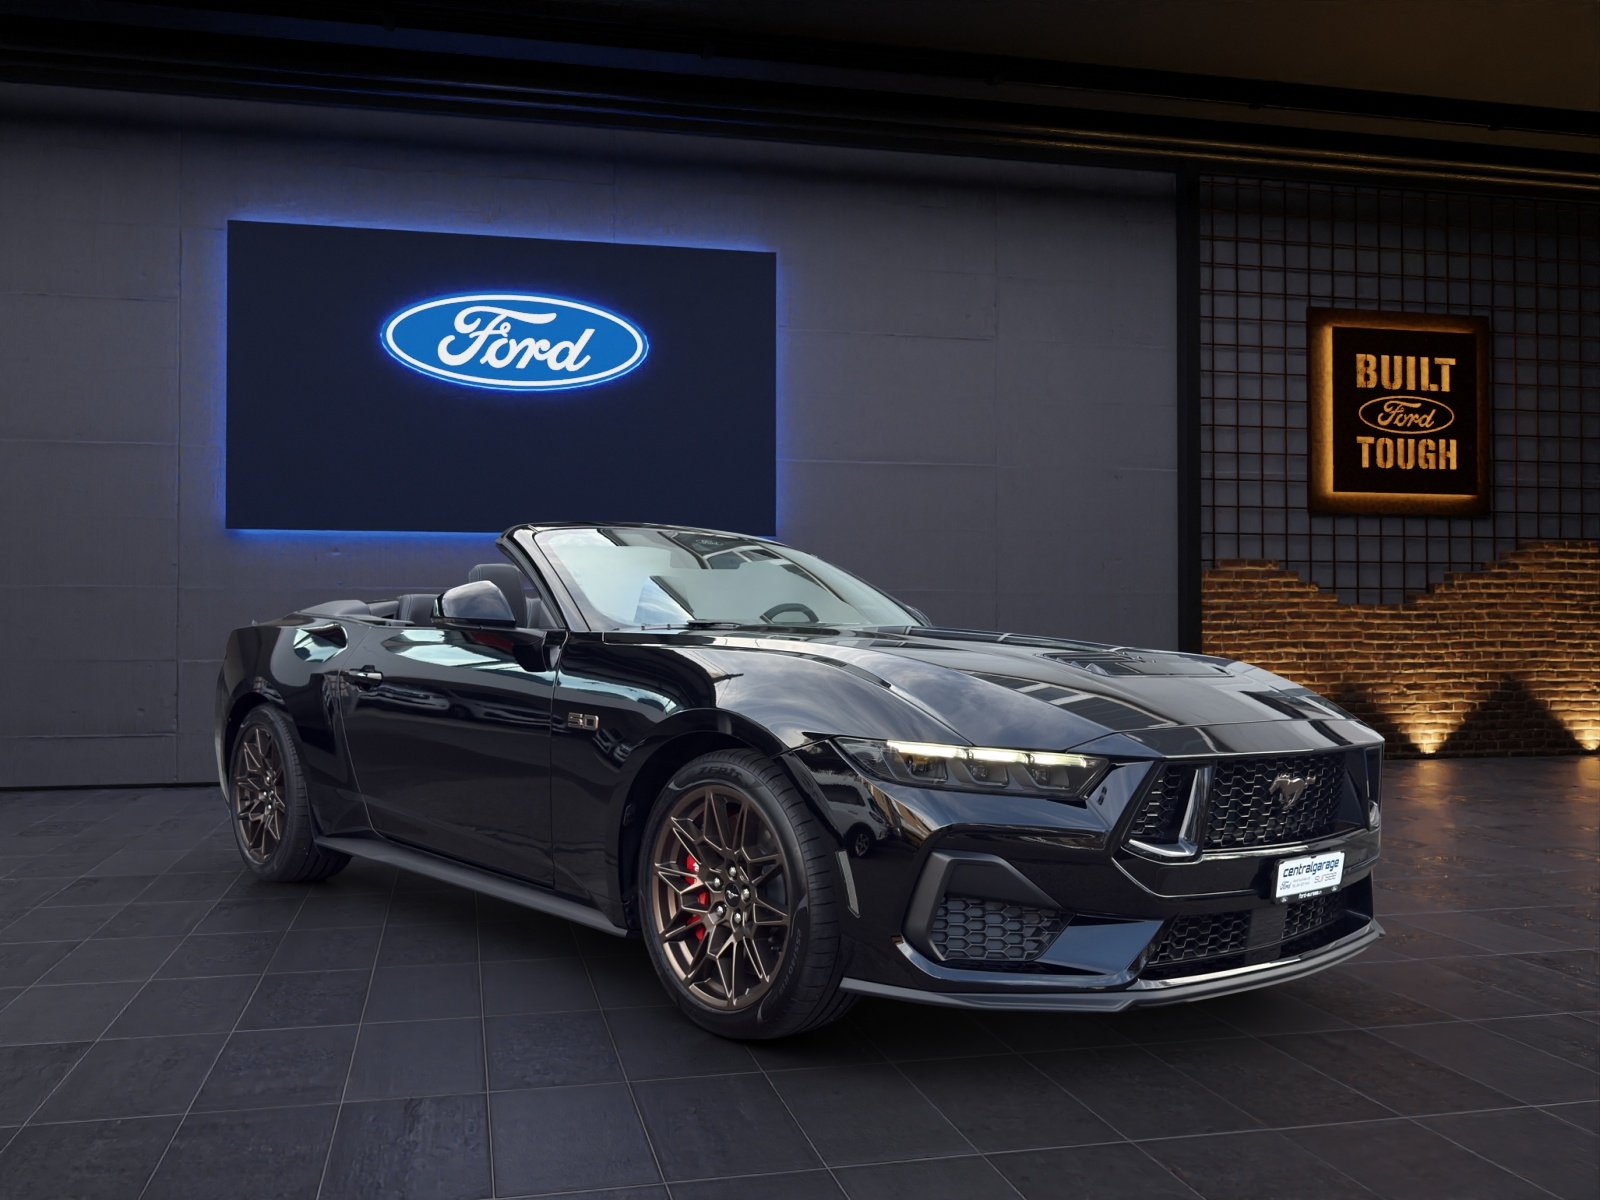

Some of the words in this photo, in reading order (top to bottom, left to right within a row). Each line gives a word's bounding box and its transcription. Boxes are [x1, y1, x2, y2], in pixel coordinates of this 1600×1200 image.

[437, 305, 596, 372] Ford
[1355, 353, 1456, 392] BUILT
[1377, 400, 1437, 428] Ford
[1356, 436, 1458, 470] TOUGH
[1283, 859, 1340, 877] centralgarage
